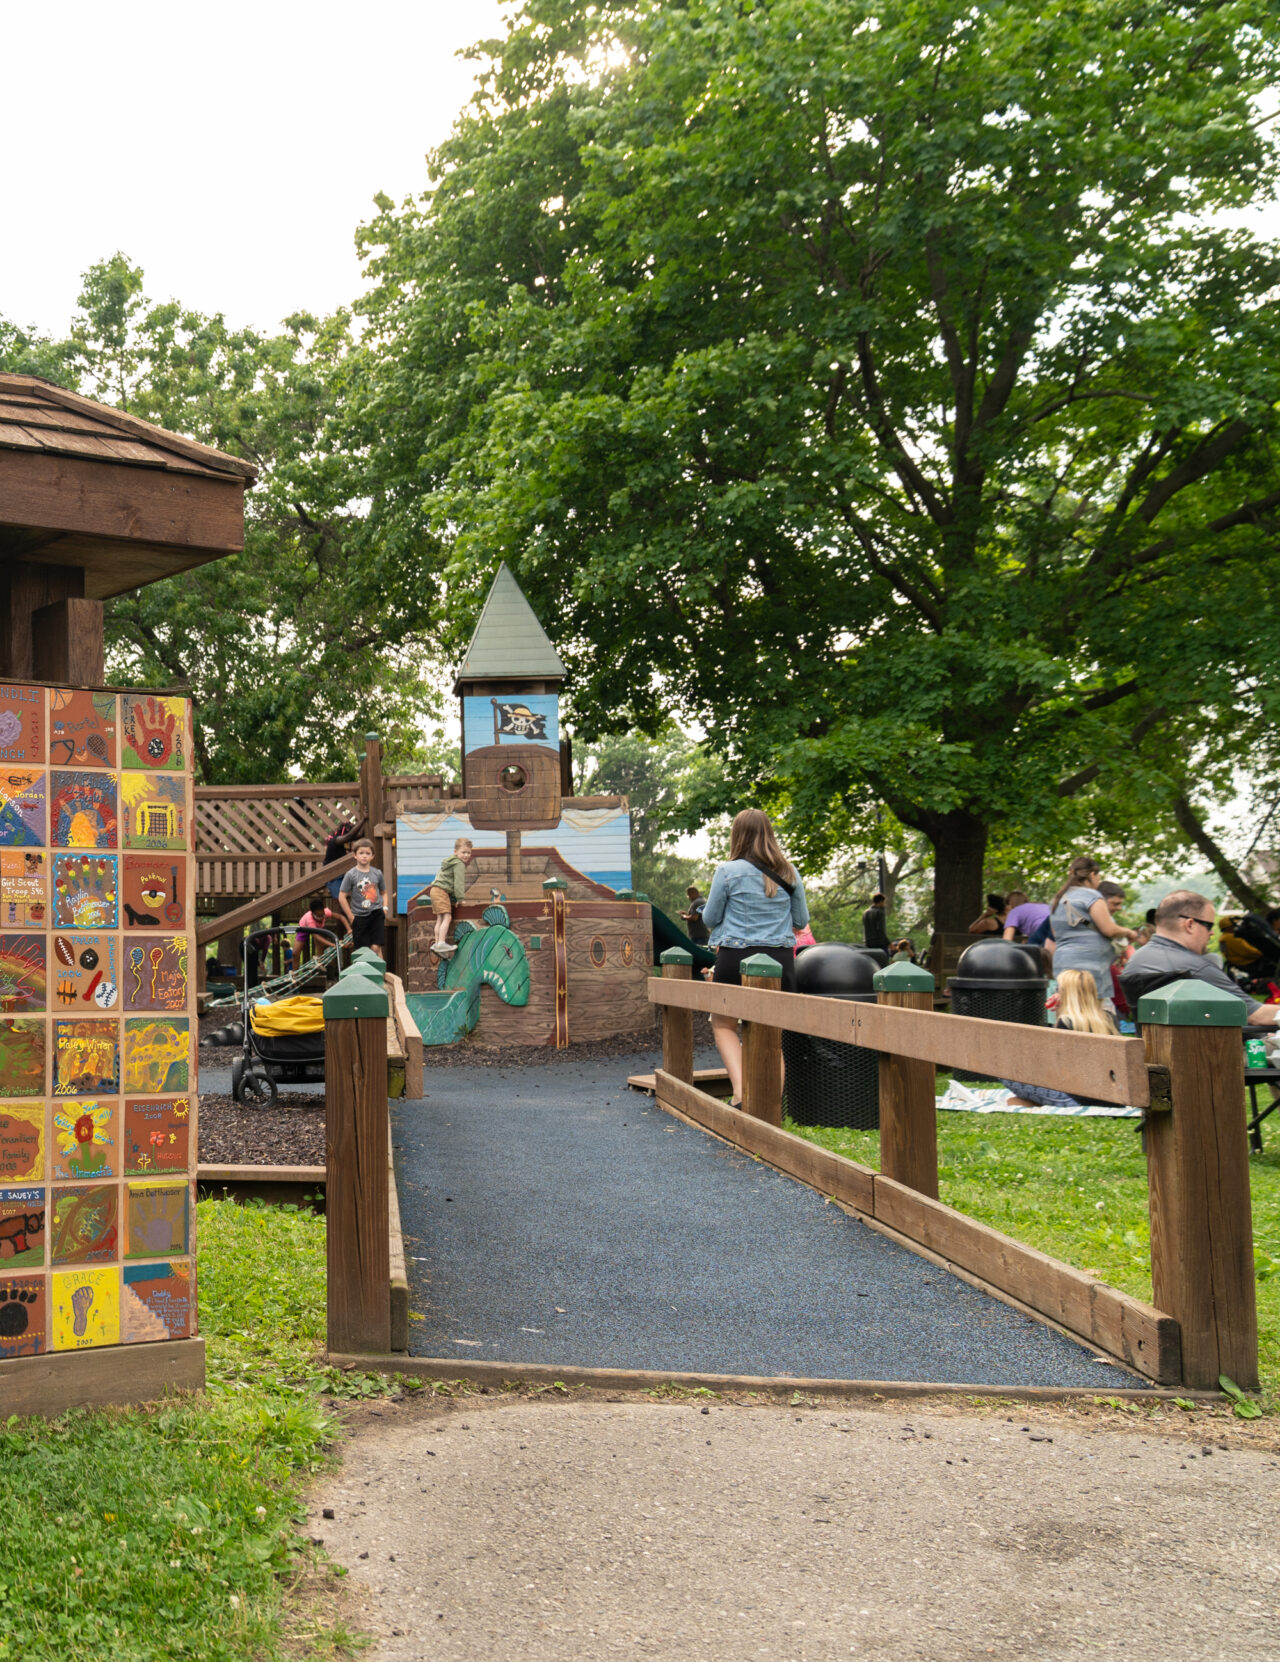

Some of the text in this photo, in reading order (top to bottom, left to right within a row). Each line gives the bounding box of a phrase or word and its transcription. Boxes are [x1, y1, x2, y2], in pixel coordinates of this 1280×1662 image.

[14, 790, 45, 799] Jordan
[1, 878, 39, 887] Girl Scout
[7, 1190, 40, 1200] SAUEY'S
[63, 1272, 105, 1289] GRACE
